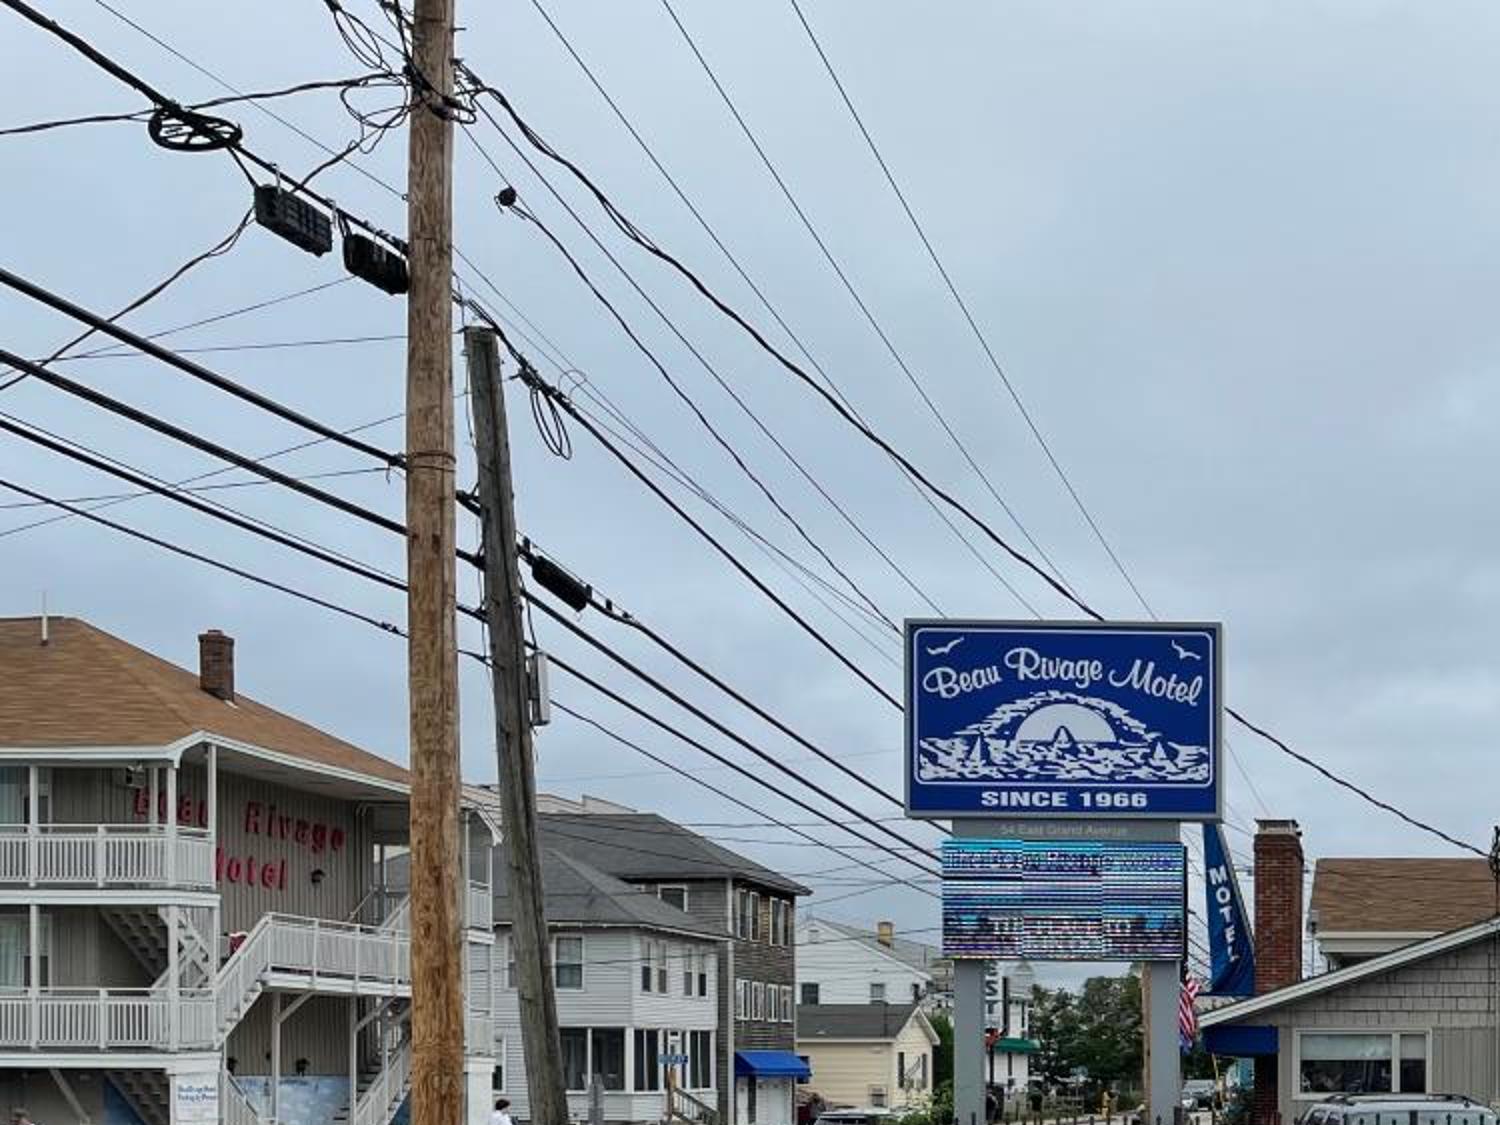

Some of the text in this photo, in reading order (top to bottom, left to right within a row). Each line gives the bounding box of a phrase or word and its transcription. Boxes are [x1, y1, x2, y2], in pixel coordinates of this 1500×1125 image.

[922, 647, 1203, 706] Beau Rivage Motel
[981, 791, 1148, 808] SINCE 1966
[1209, 865, 1240, 962] MOTEL
